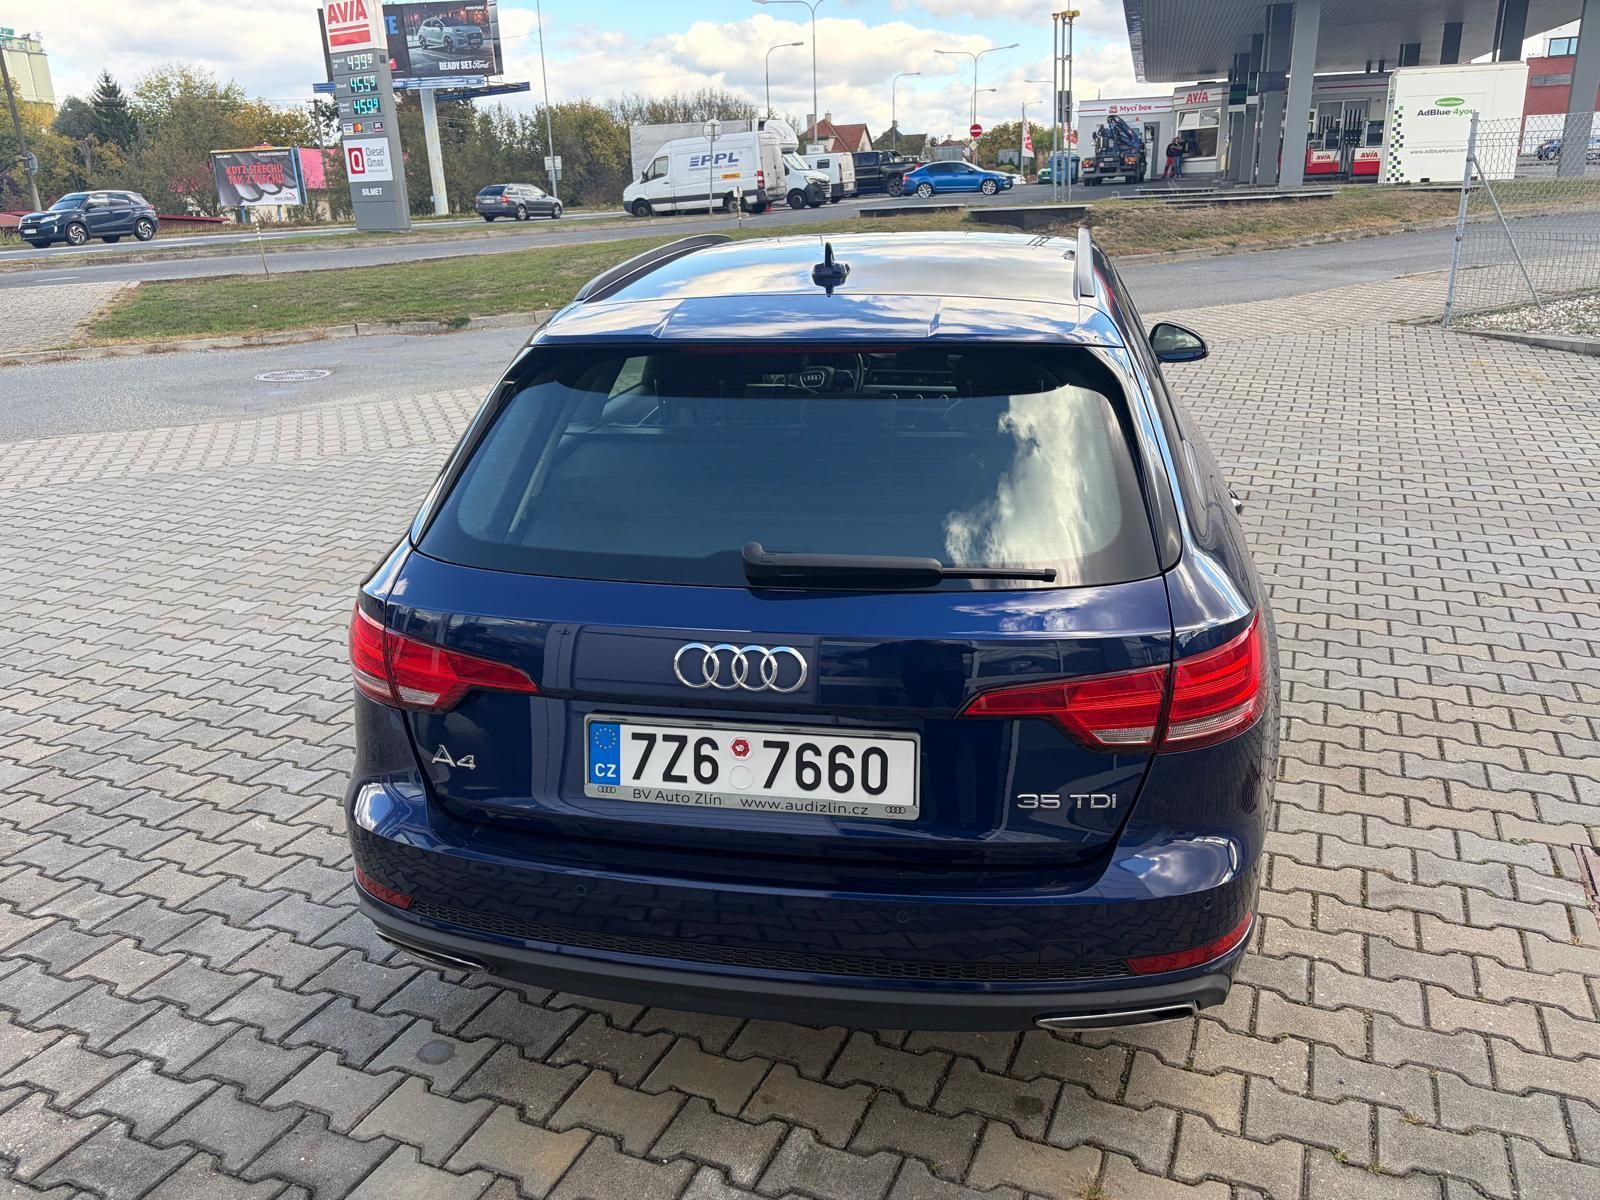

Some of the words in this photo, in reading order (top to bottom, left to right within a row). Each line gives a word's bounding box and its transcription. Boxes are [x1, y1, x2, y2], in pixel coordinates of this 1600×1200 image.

[327, 0, 368, 25] AVIA
[439, 61, 460, 71] READY
[460, 60, 473, 70] SET
[472, 59, 490, 69] Ford
[1186, 90, 1209, 104] AVIA
[1417, 108, 1451, 117] AdBlue
[365, 147, 385, 157] Diesel
[1360, 151, 1378, 159] AVIA
[228, 175, 244, 185] TAK
[361, 187, 382, 196] SILMET
[431, 744, 476, 770] A4
[631, 732, 719, 785] 7Z6
[763, 740, 889, 796] 7660
[595, 763, 616, 778] CZ
[632, 788, 652, 801] BV
[654, 790, 690, 806] Auto
[694, 792, 722, 806] Zlín
[740, 797, 868, 816] www.audizlin.cz
[1016, 793, 1061, 809] 35
[1069, 793, 1117, 809] TDI
